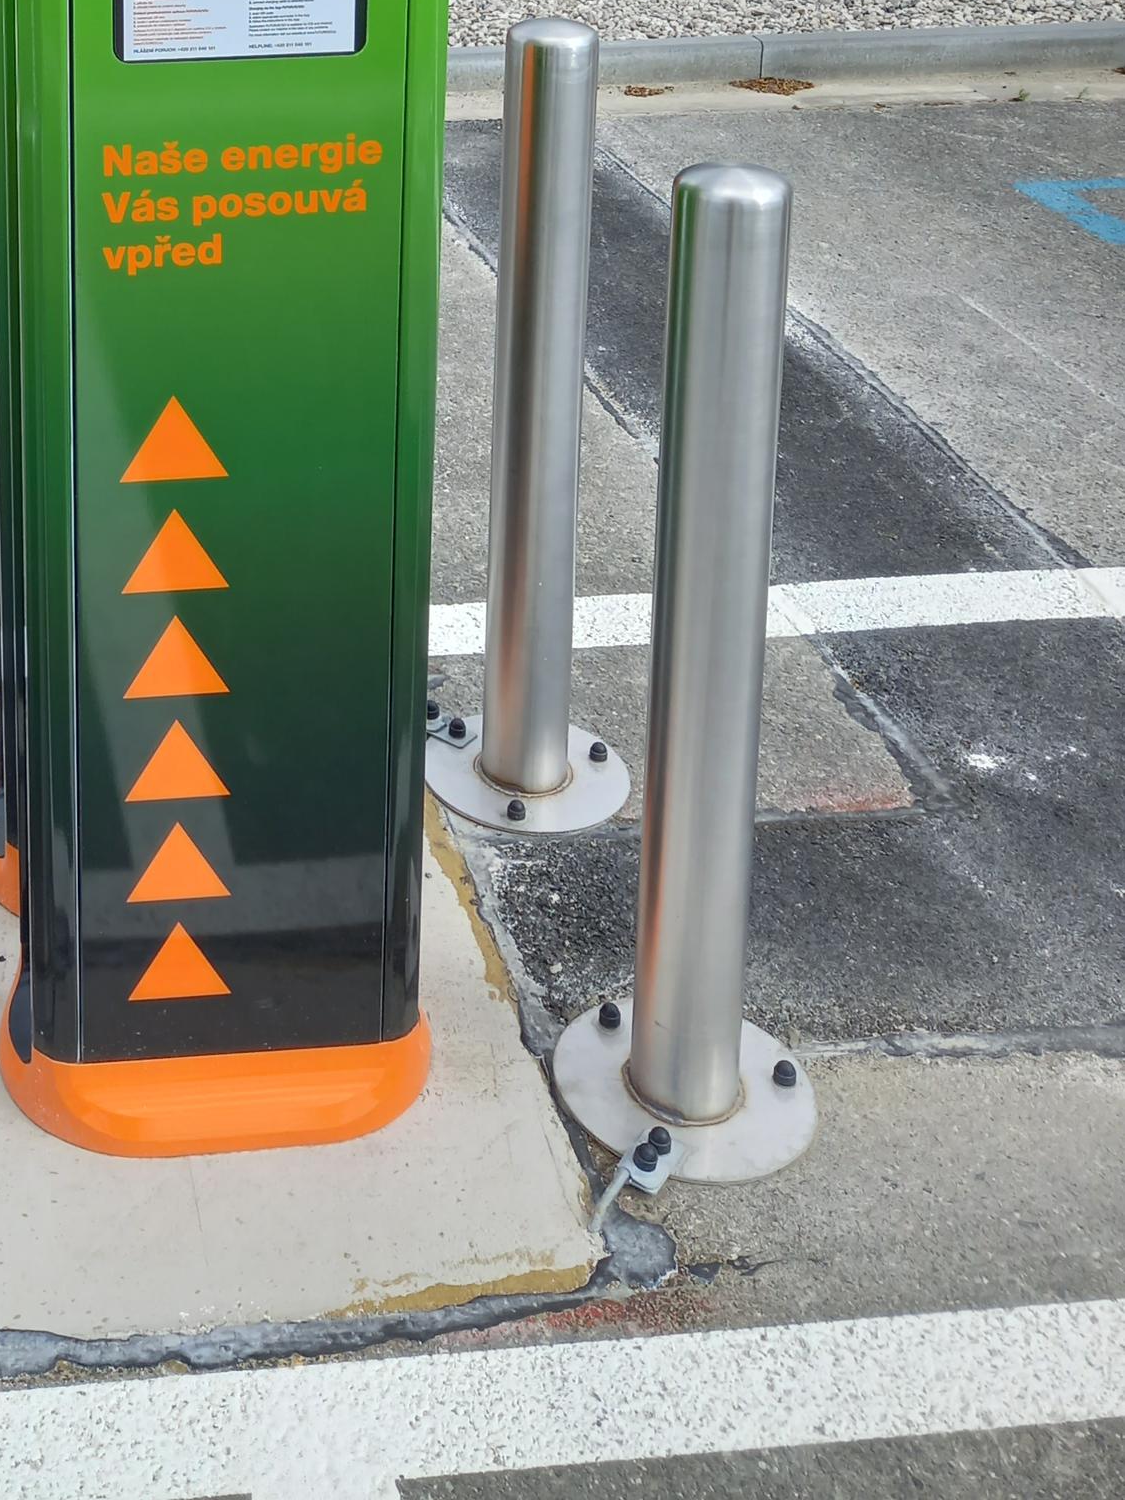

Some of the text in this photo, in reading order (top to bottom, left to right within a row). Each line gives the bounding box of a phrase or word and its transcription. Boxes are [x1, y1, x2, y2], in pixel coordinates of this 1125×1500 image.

[103, 133, 382, 177] Naše energie
[102, 179, 367, 226] Vás posouvá
[102, 233, 223, 276] vpřed
